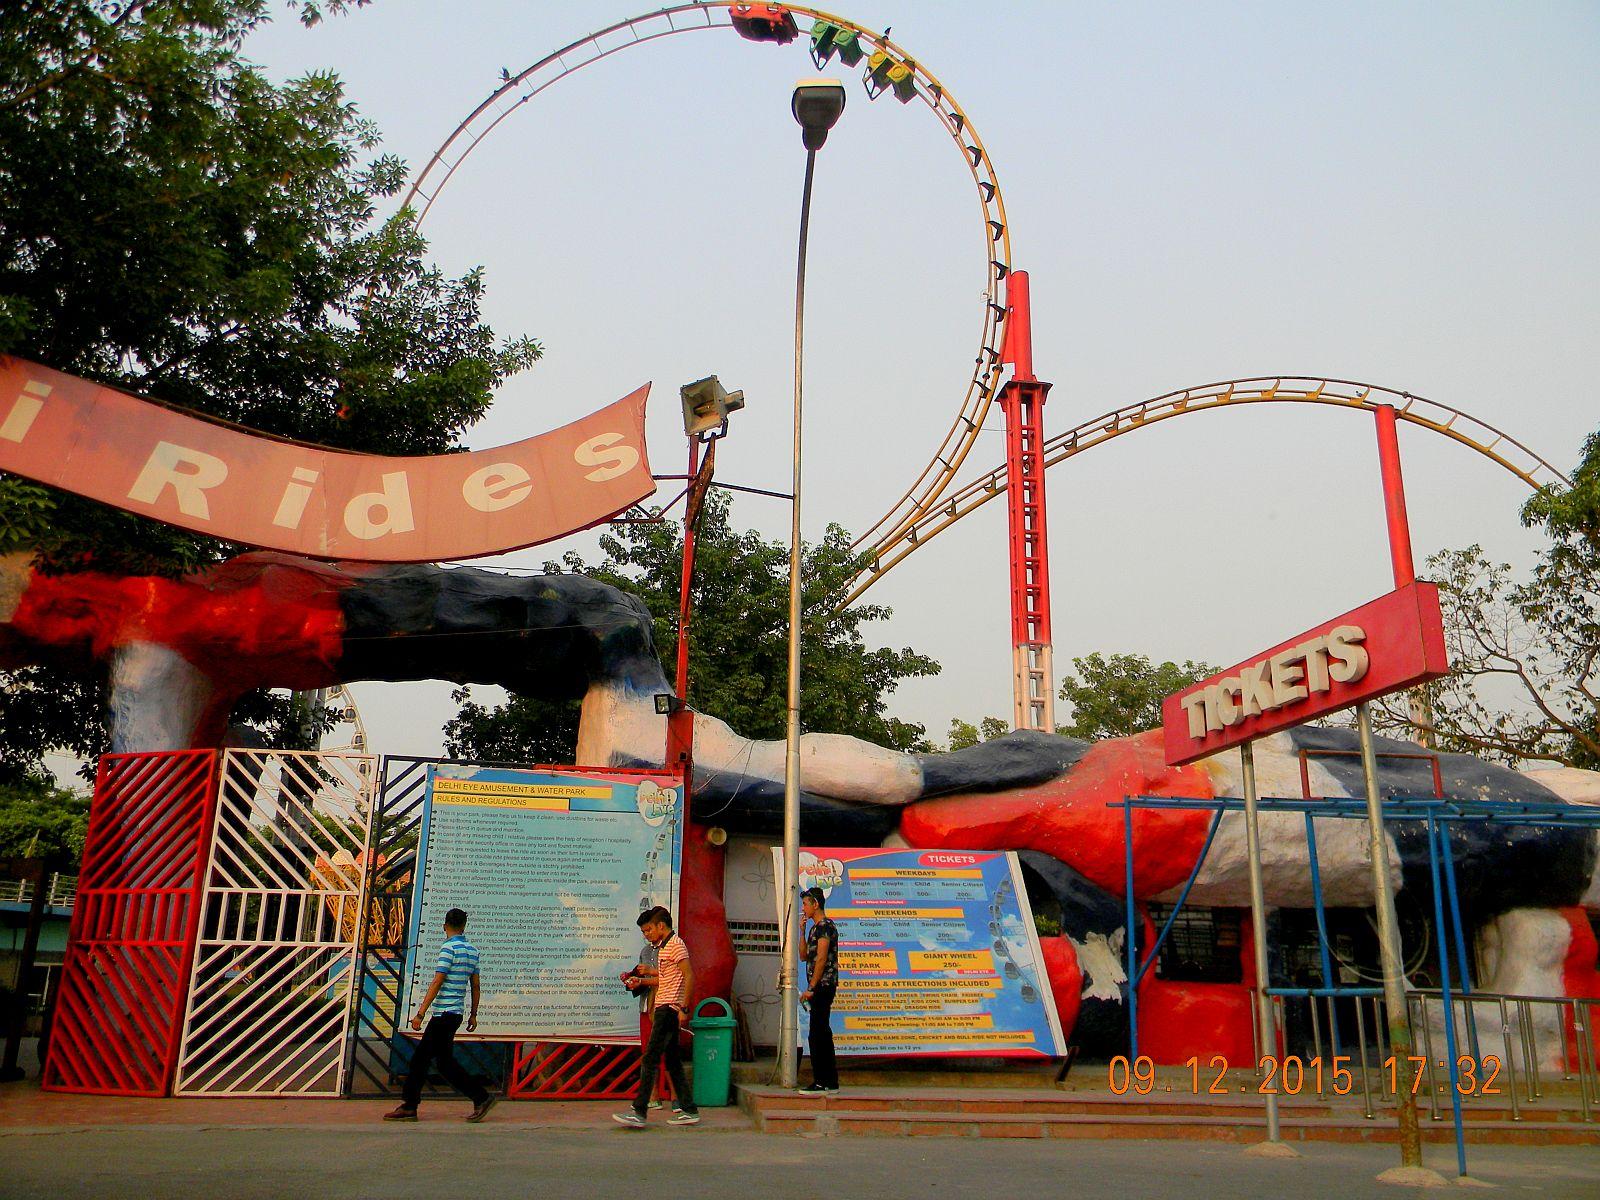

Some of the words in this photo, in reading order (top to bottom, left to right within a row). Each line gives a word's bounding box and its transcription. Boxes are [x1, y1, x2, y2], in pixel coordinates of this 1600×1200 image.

[127, 432, 639, 540] Rides
[1181, 625, 1369, 740] TICKETS
[480, 784, 529, 793] AMUSEMENT
[531, 786, 536, 794] &
[538, 787, 564, 795] WATER
[566, 788, 586, 796] PARK
[462, 796, 477, 804] AND
[478, 798, 527, 806] REGULATIONS
[928, 855, 976, 864] TICKETS
